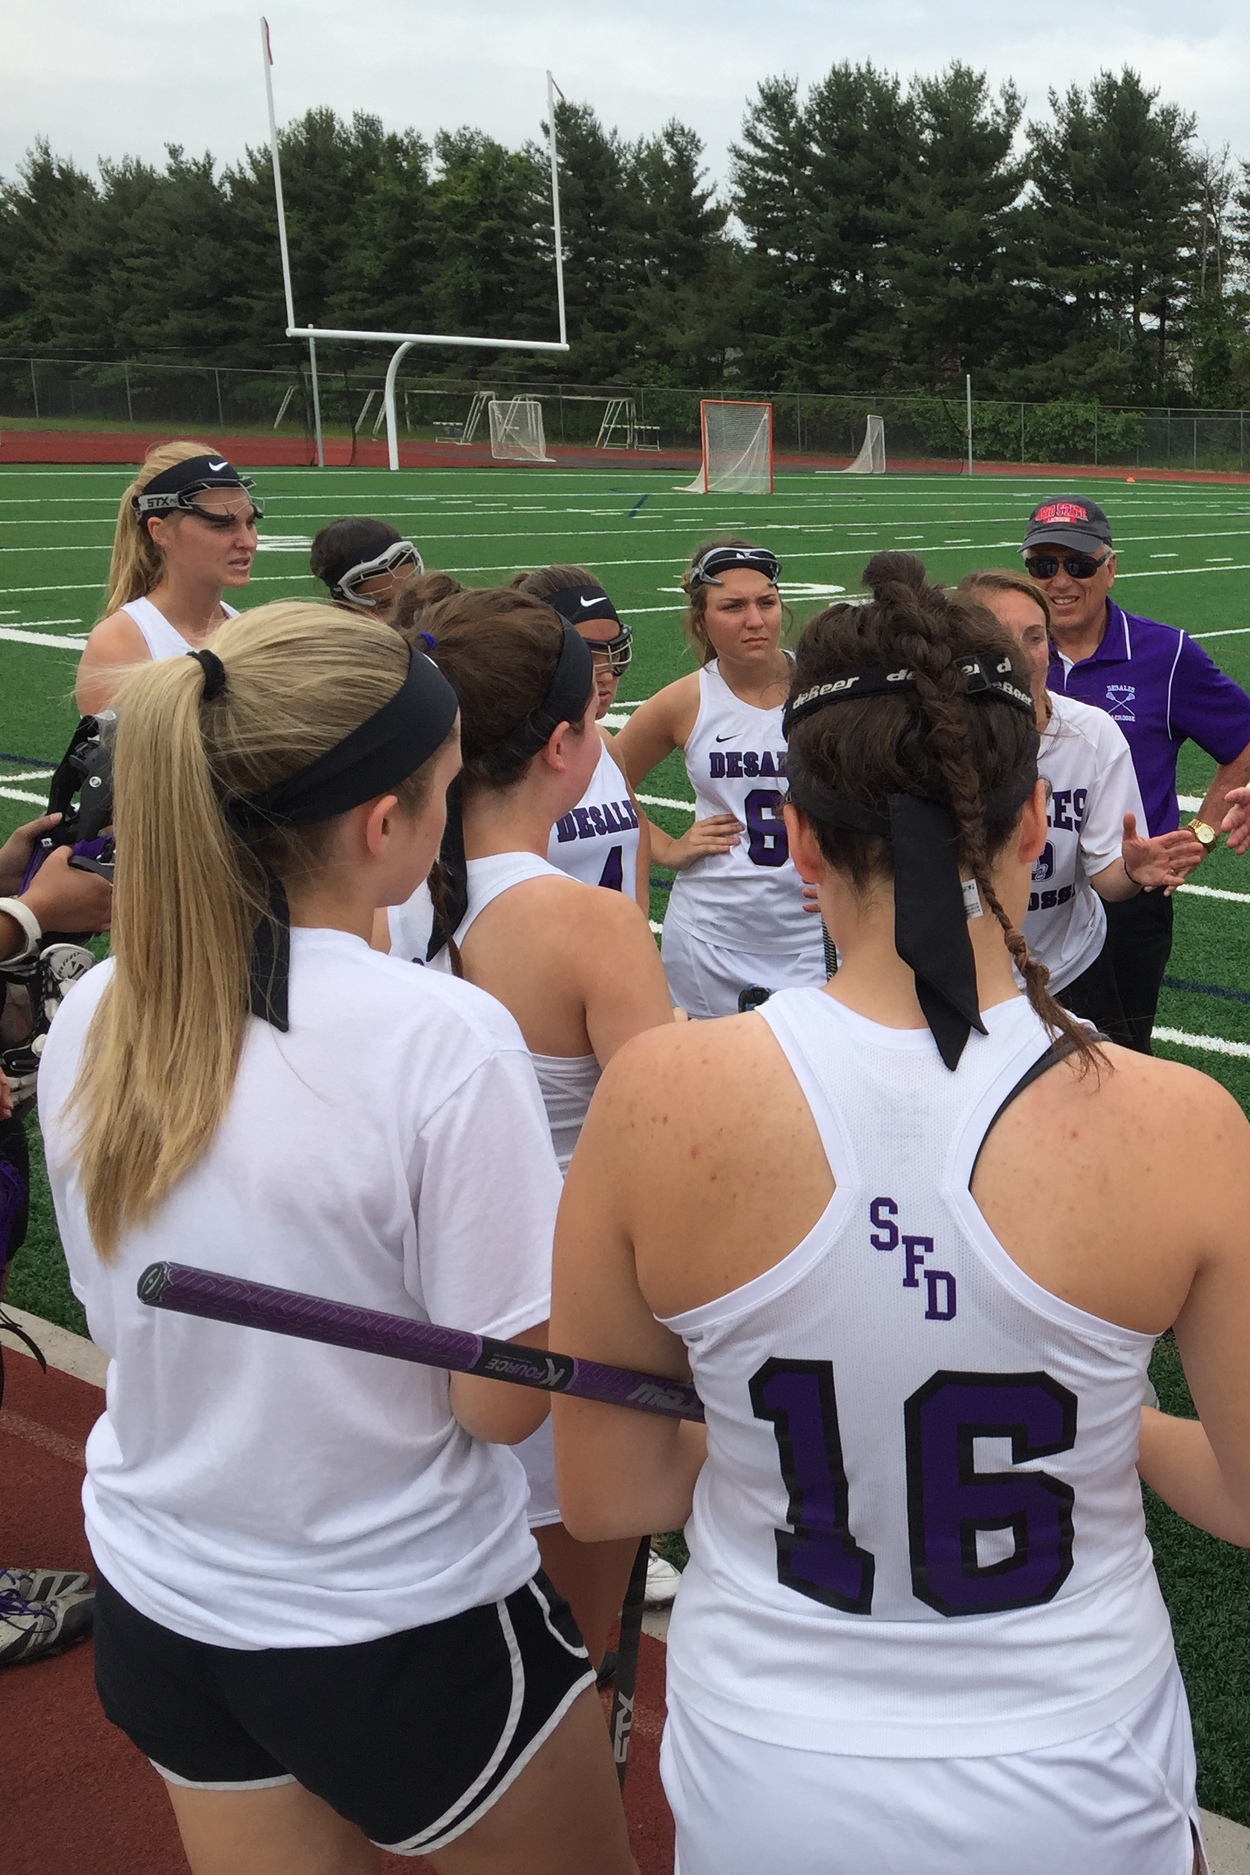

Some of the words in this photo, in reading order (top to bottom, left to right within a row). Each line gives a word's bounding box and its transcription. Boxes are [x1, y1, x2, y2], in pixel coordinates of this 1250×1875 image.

[147, 496, 169, 508] STX
[792, 676, 860, 710] deBeer
[870, 1197, 957, 1321] SFD
[748, 1356, 1078, 1617] 16
